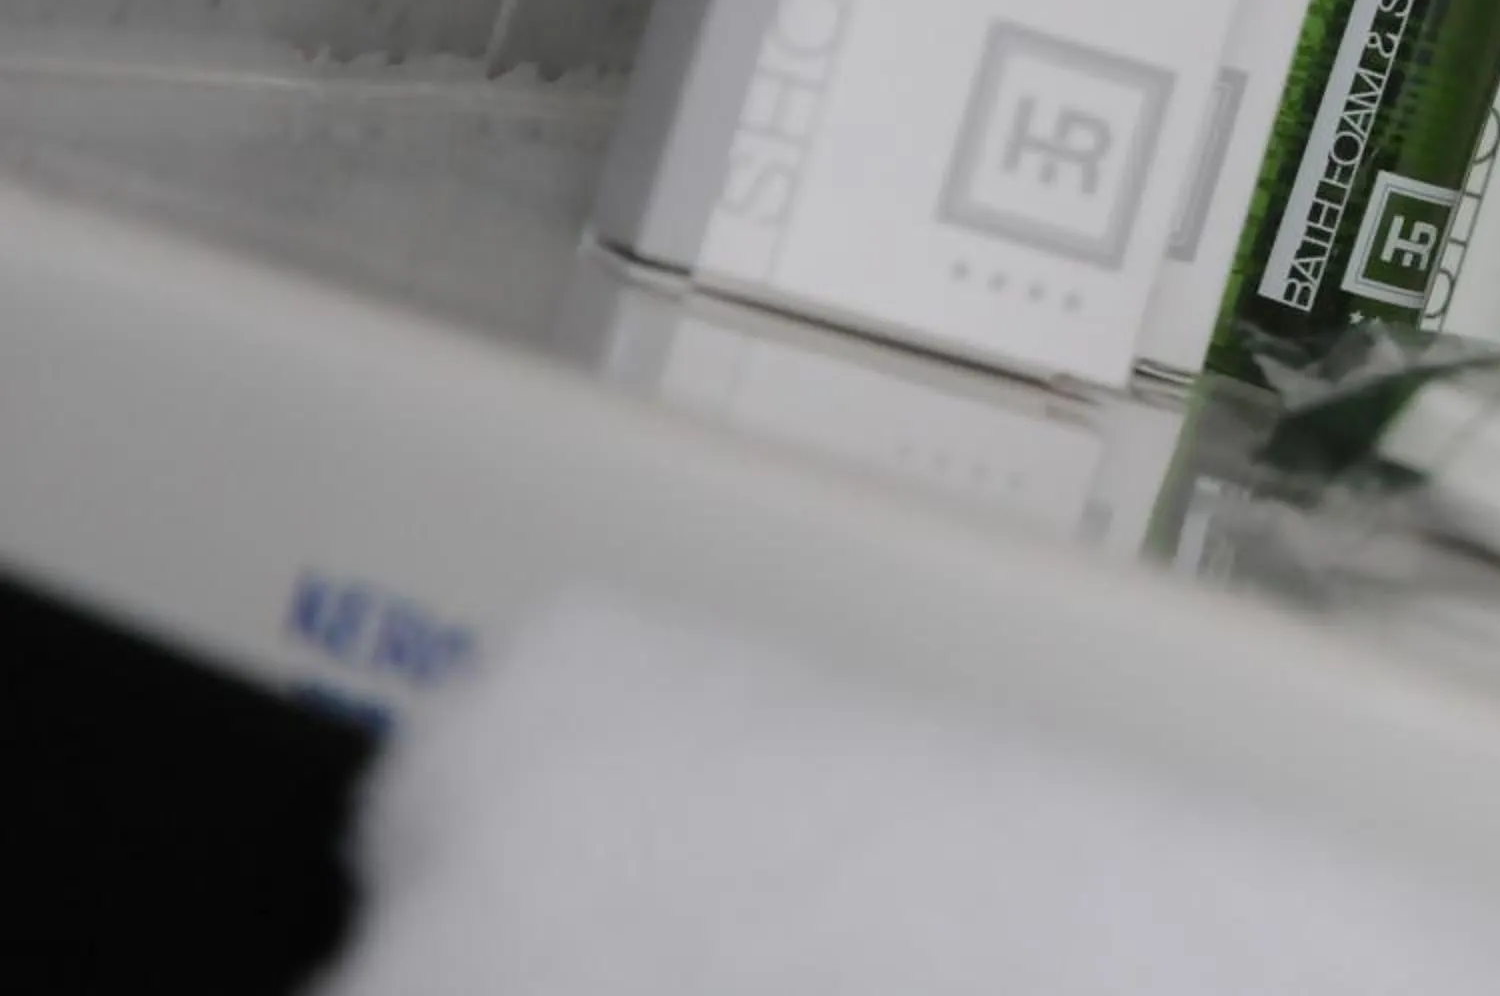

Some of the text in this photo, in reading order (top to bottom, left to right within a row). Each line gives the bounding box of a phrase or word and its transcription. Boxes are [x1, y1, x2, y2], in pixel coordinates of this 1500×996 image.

[1282, 197, 1344, 311] BATH
[1319, 67, 1387, 190] FOAM
[1366, 30, 1398, 58] &
